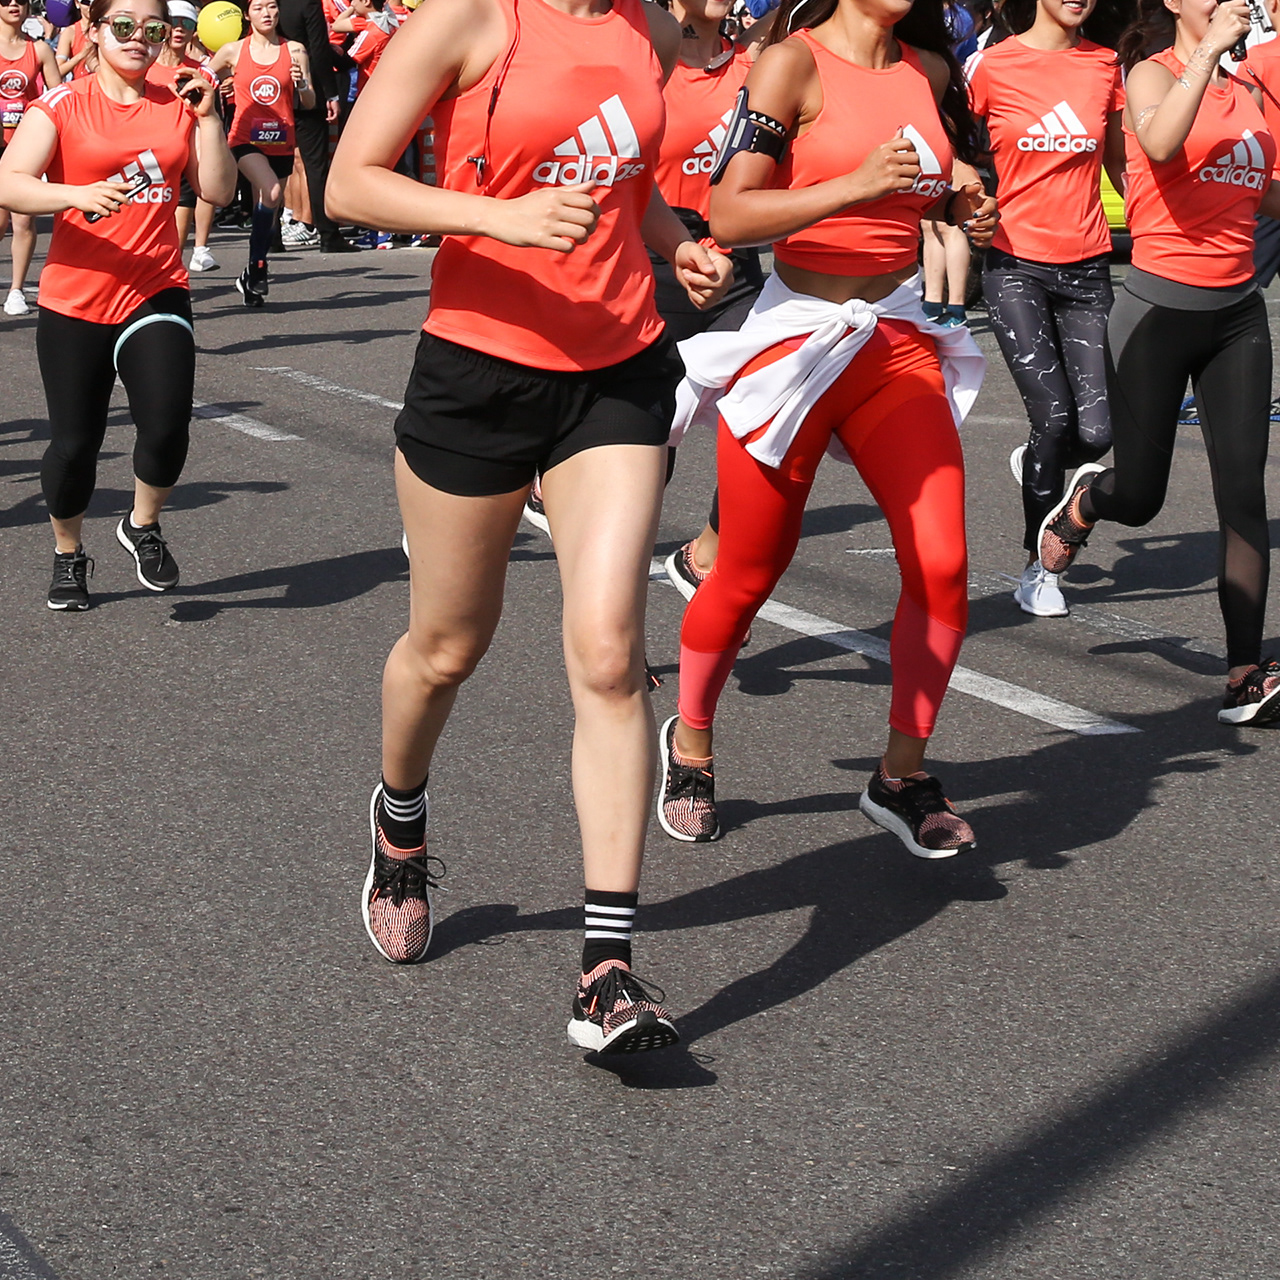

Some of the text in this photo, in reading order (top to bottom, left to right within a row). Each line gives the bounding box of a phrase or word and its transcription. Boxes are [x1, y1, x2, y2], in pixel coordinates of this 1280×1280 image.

[257, 131, 281, 140] 2677
[1016, 133, 1097, 153] adidas
[532, 154, 644, 187] adidas
[1198, 163, 1267, 191] adidas
